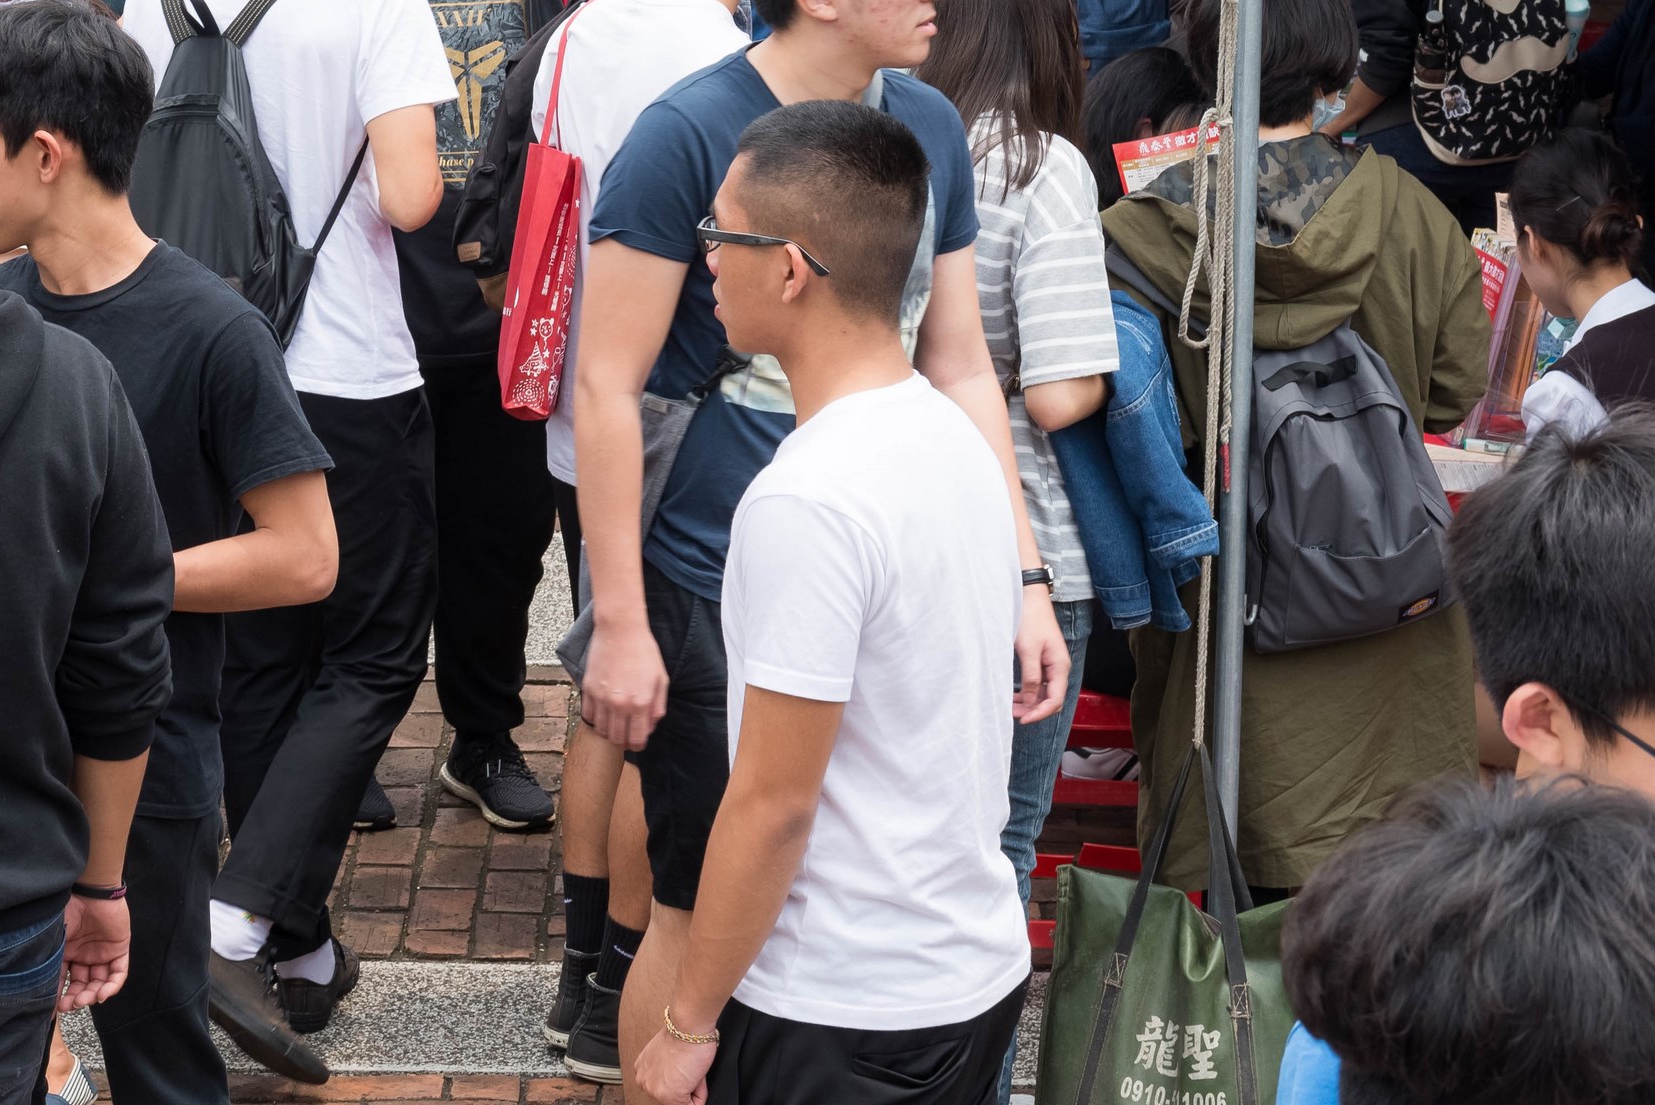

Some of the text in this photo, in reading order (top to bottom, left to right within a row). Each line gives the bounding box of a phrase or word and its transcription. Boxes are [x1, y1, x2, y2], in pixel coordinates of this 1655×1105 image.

[1174, 126, 1220, 148] 徵才缺
[1134, 1015, 1222, 1081] 龍聖
